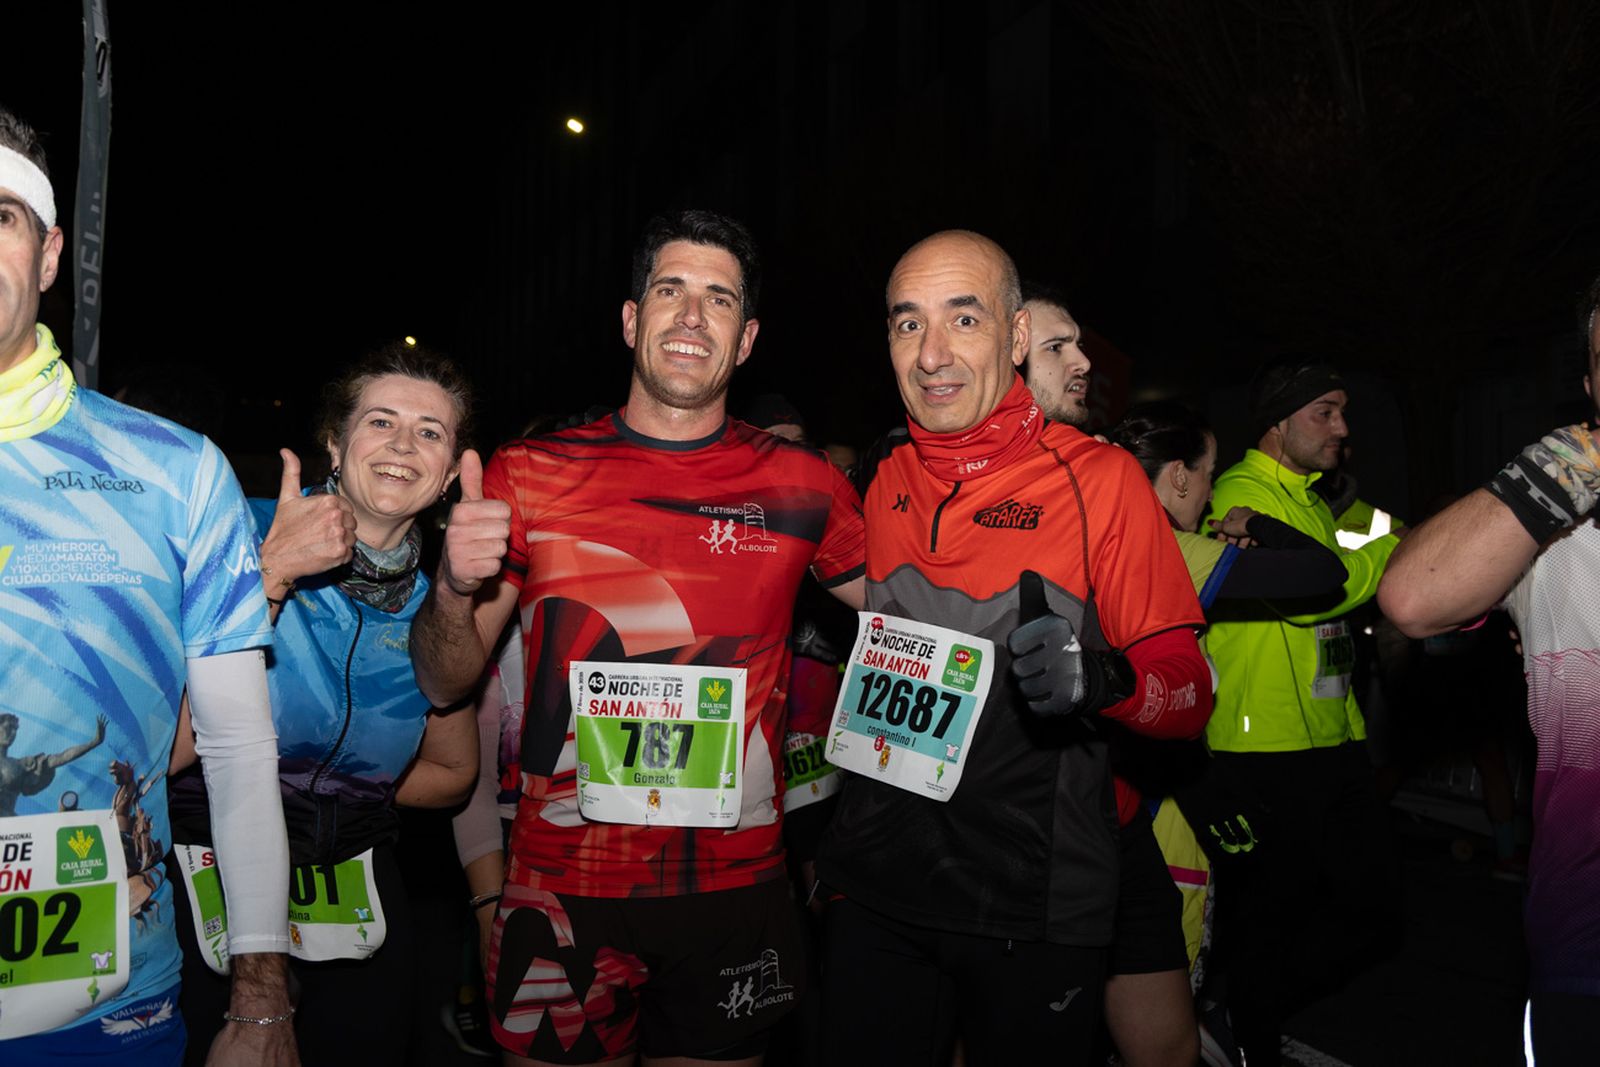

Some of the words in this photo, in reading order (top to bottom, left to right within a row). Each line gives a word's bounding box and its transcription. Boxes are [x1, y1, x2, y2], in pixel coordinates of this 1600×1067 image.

[44, 471, 86, 490] PATA
[698, 505, 744, 515] ATLETISMO
[980, 504, 1039, 528] ATARFE
[25, 542, 106, 553] MUYHEROICA
[738, 543, 778, 553] ALBOLOTE
[881, 634, 919, 656] NOCHE
[917, 642, 937, 660] DE
[863, 649, 887, 670] SAN
[885, 657, 931, 681] ANTÓN
[589, 676, 605, 689] 43
[608, 681, 659, 697] NOCHE
[663, 682, 683, 698] DE
[588, 699, 622, 717] SAN
[624, 697, 683, 719] ANTÓN
[856, 671, 962, 740] 12687
[620, 721, 694, 769] 787
[633, 772, 676, 785] Gonzalo
[2, 841, 34, 863] DE
[60, 862, 79, 871] CAJA
[80, 858, 104, 868] RURAL
[0, 892, 82, 963] 02
[719, 959, 761, 977] ATLETISMO
[754, 991, 794, 1010] ALBOLOTE
